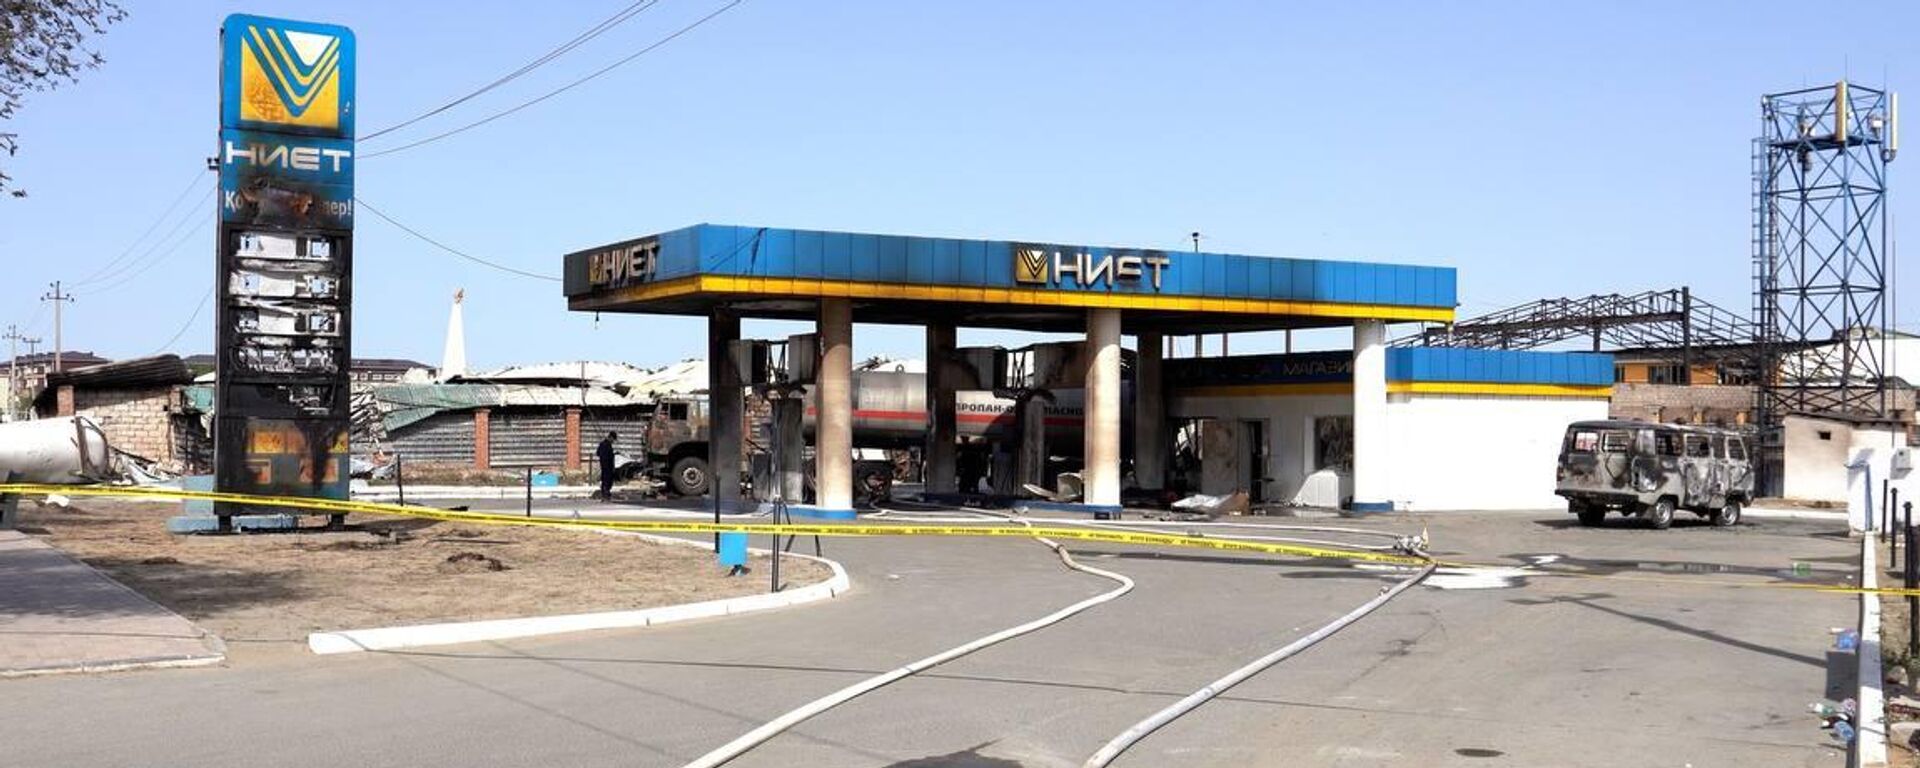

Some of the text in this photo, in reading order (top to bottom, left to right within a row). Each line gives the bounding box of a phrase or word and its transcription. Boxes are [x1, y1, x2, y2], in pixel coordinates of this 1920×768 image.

[225, 141, 351, 172] НИЕТ
[603, 241, 658, 284] НИЕТ
[1054, 252, 1170, 289] НИЕТ
